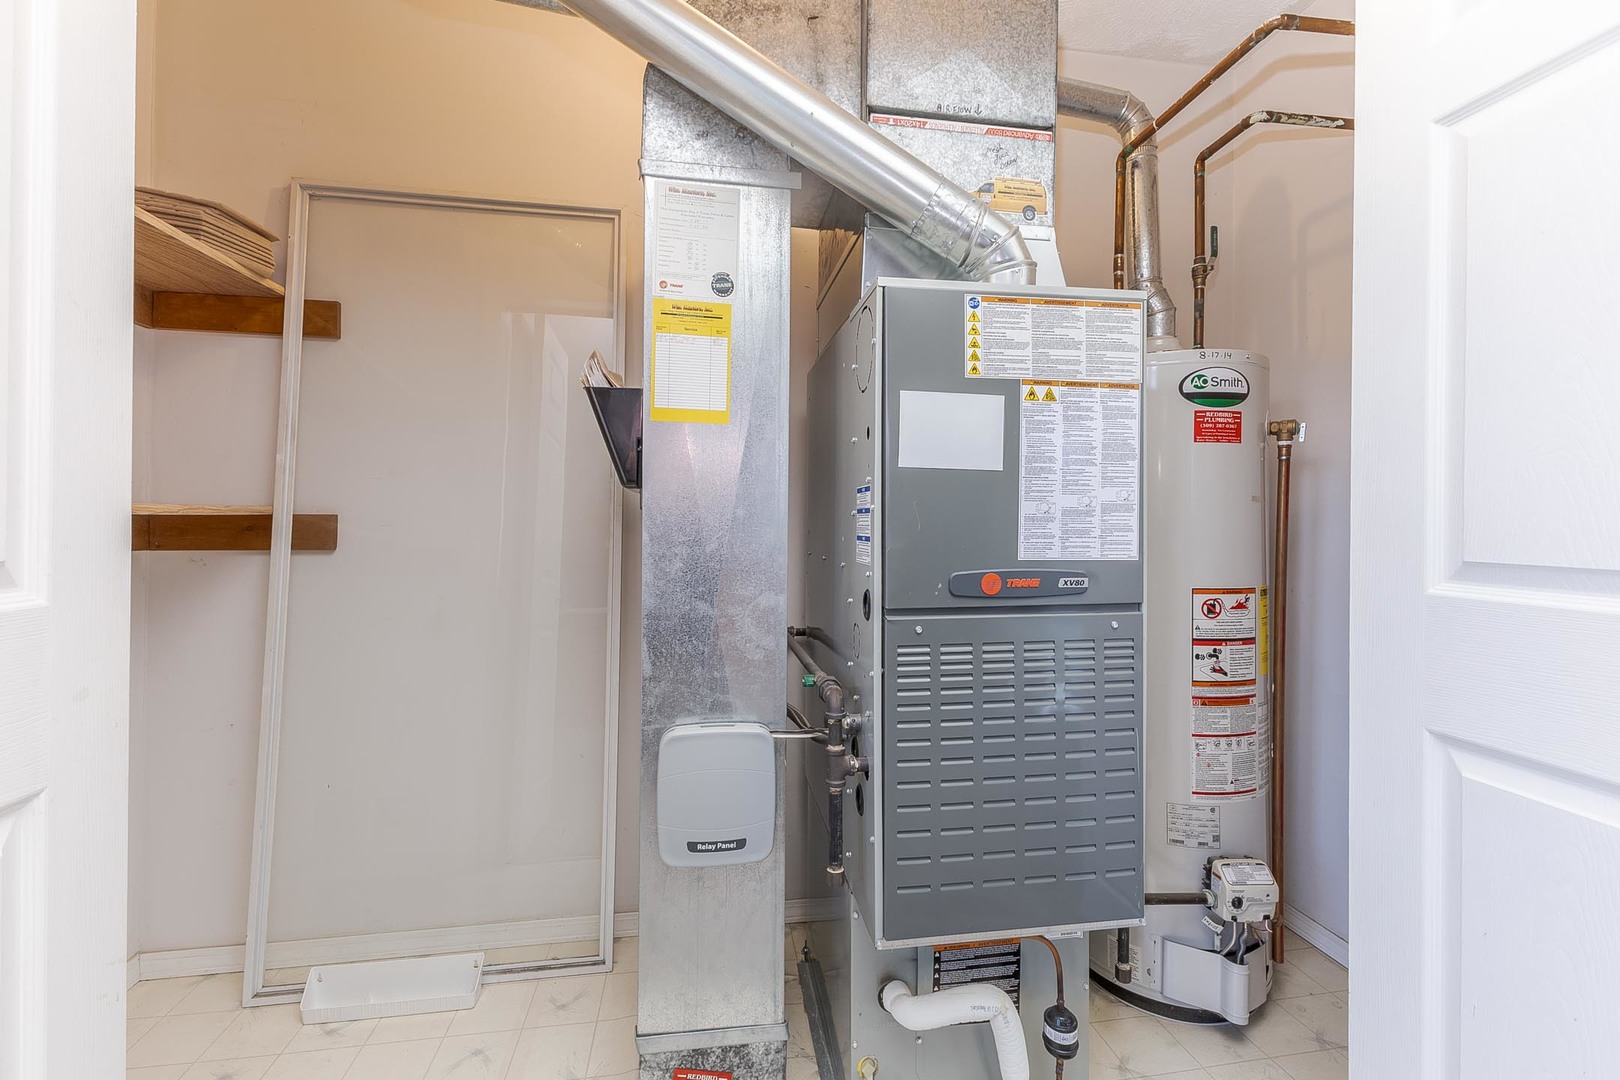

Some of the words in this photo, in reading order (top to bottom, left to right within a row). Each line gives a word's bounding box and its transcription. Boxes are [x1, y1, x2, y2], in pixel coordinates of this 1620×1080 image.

[1003, 131, 1034, 140] Advanced
[1211, 376, 1243, 388] Smith
[1006, 578, 1041, 588] TRANE
[697, 843, 716, 851] Relay
[717, 841, 737, 849] Panel
